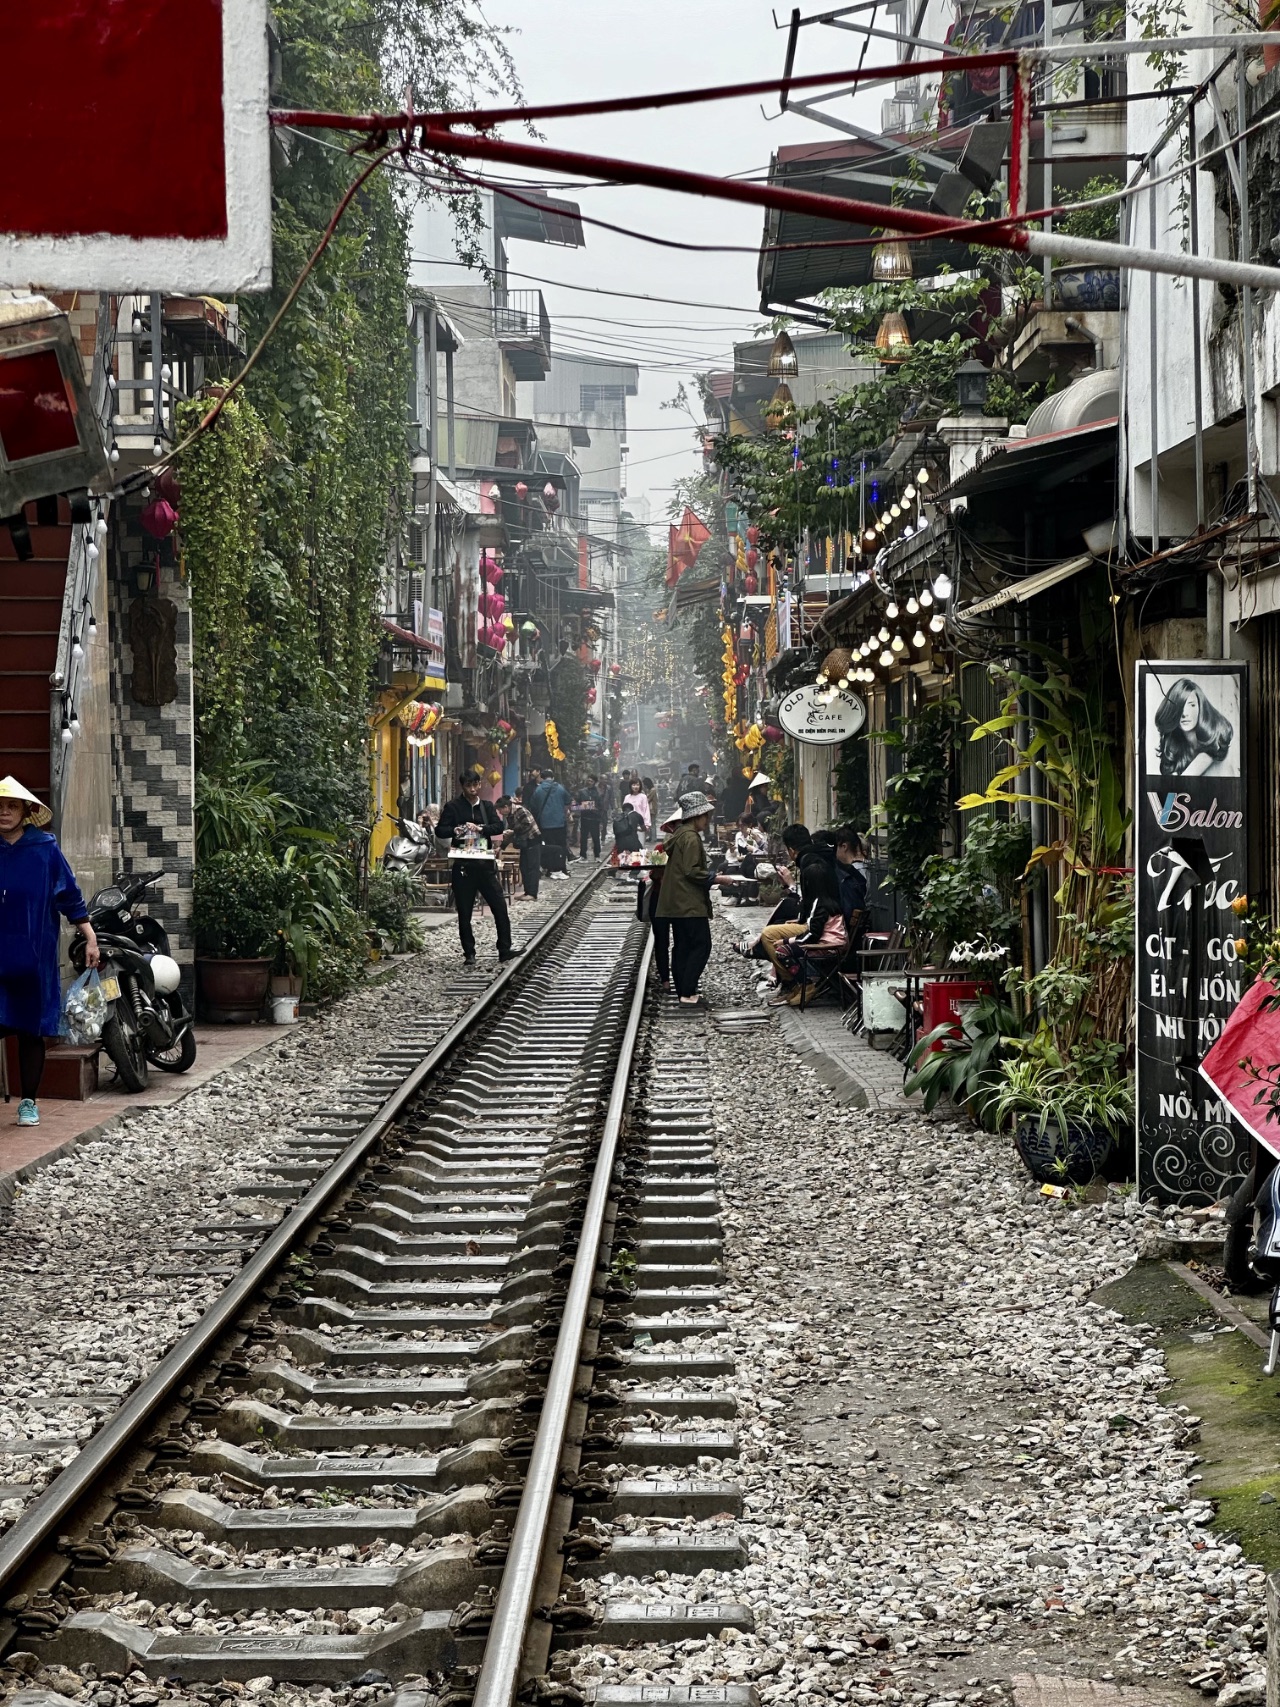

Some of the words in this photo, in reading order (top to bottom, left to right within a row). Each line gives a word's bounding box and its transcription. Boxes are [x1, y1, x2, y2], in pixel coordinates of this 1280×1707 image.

[784, 693, 804, 712] OLD
[813, 688, 859, 712] RWAY
[1206, 933, 1245, 968] GỘ
[1155, 1012, 1228, 1046] NHUỘ
